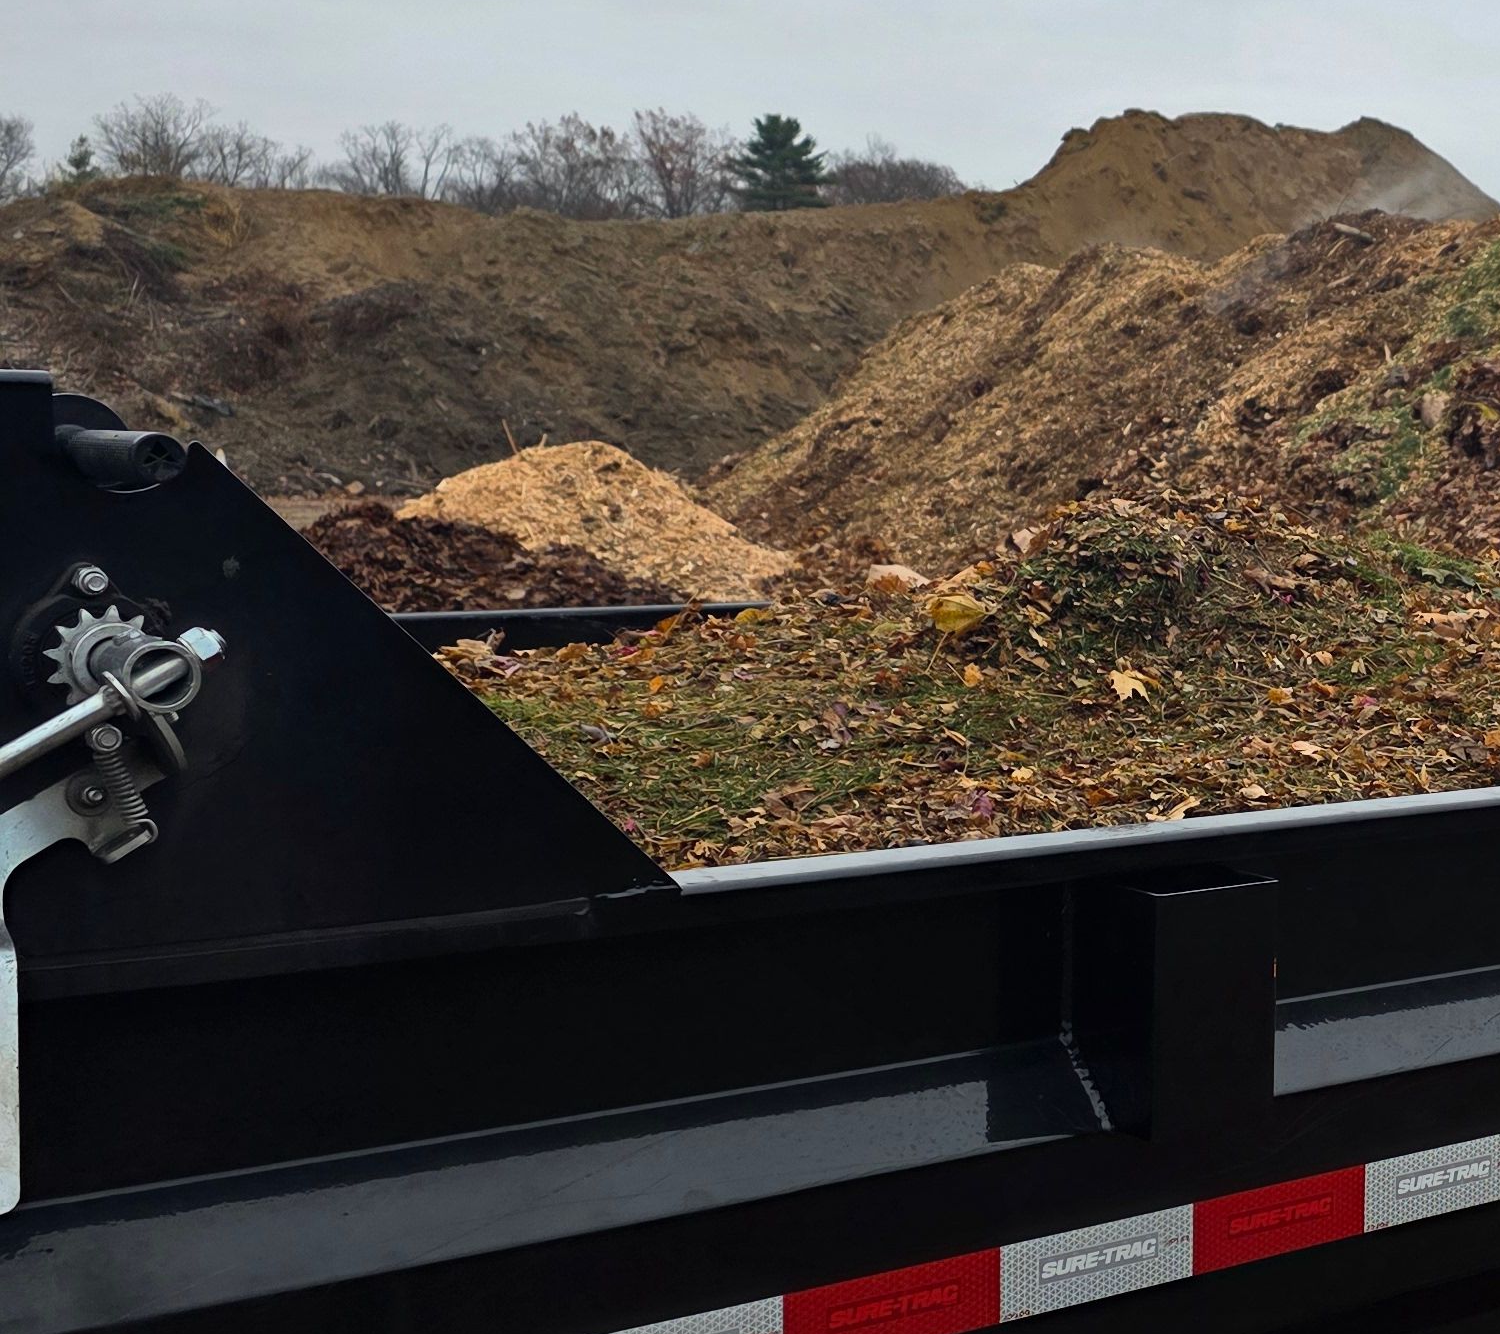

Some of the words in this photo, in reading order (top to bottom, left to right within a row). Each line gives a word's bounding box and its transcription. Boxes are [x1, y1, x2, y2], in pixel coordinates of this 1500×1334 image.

[1398, 1160, 1491, 1195] SURE-TRAC
[1229, 1197, 1331, 1234] SURE-TRAC
[1041, 1238, 1157, 1279] SURE-TRAC
[829, 1284, 959, 1329] SURE-TRAC
